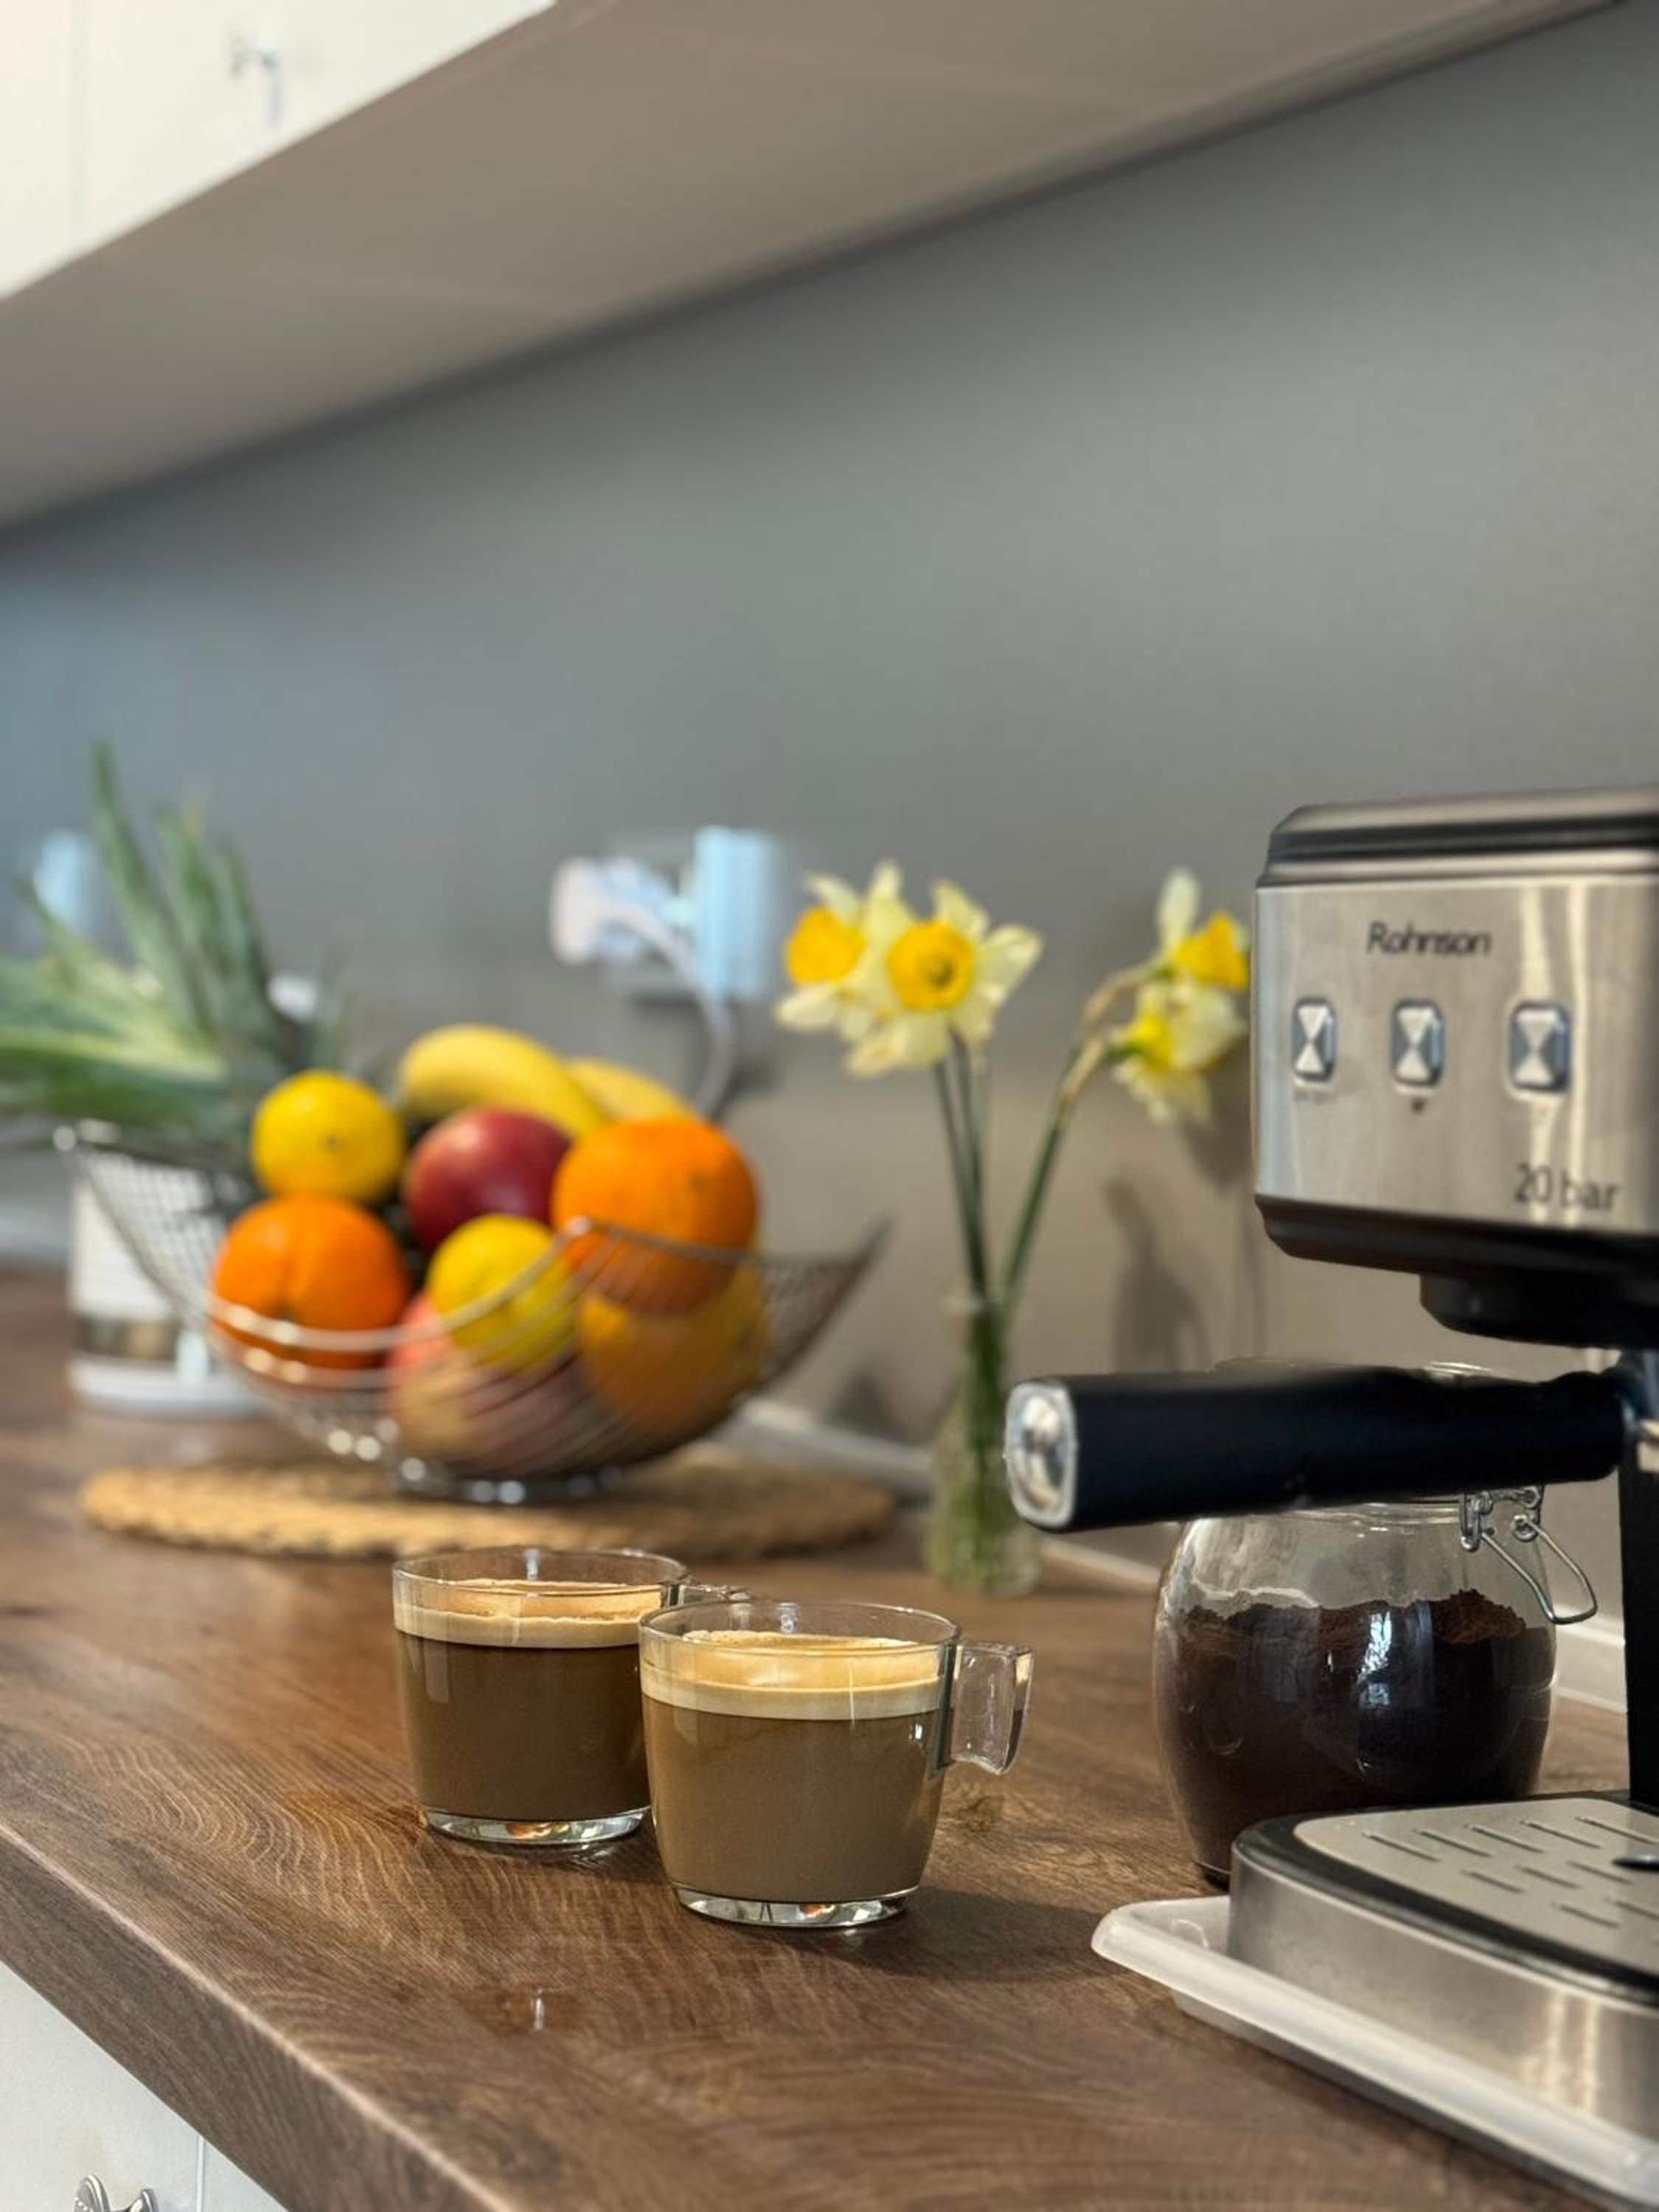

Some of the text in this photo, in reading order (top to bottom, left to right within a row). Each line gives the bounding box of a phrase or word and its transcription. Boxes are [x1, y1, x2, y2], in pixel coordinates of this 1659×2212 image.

[1367, 919, 1492, 956] Rohnson
[1514, 1161, 1621, 1211] 20 bar
